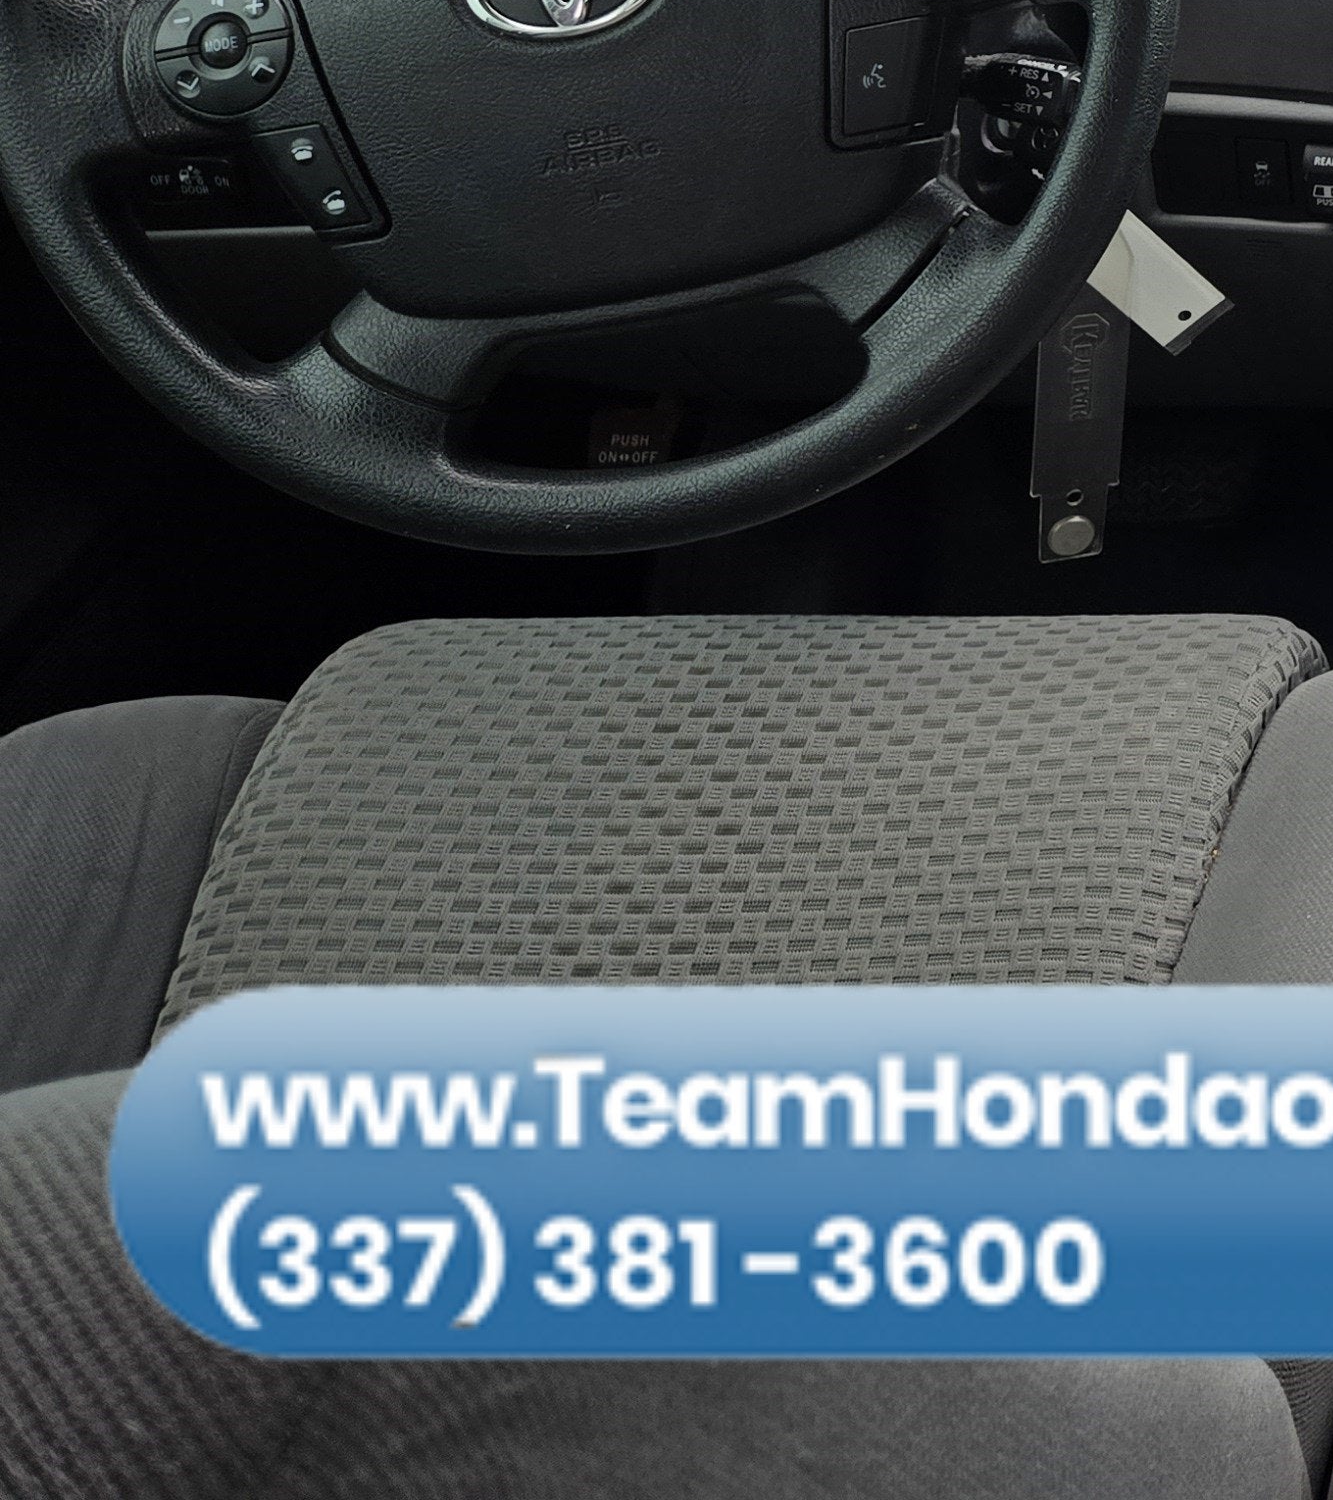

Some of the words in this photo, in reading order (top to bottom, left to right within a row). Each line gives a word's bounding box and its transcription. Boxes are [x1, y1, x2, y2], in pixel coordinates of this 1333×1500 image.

[204, 35, 239, 53] MODE
[1020, 67, 1040, 80] RES
[611, 434, 650, 447] PUSH
[599, 451, 617, 463] ON
[632, 451, 658, 463] OFF
